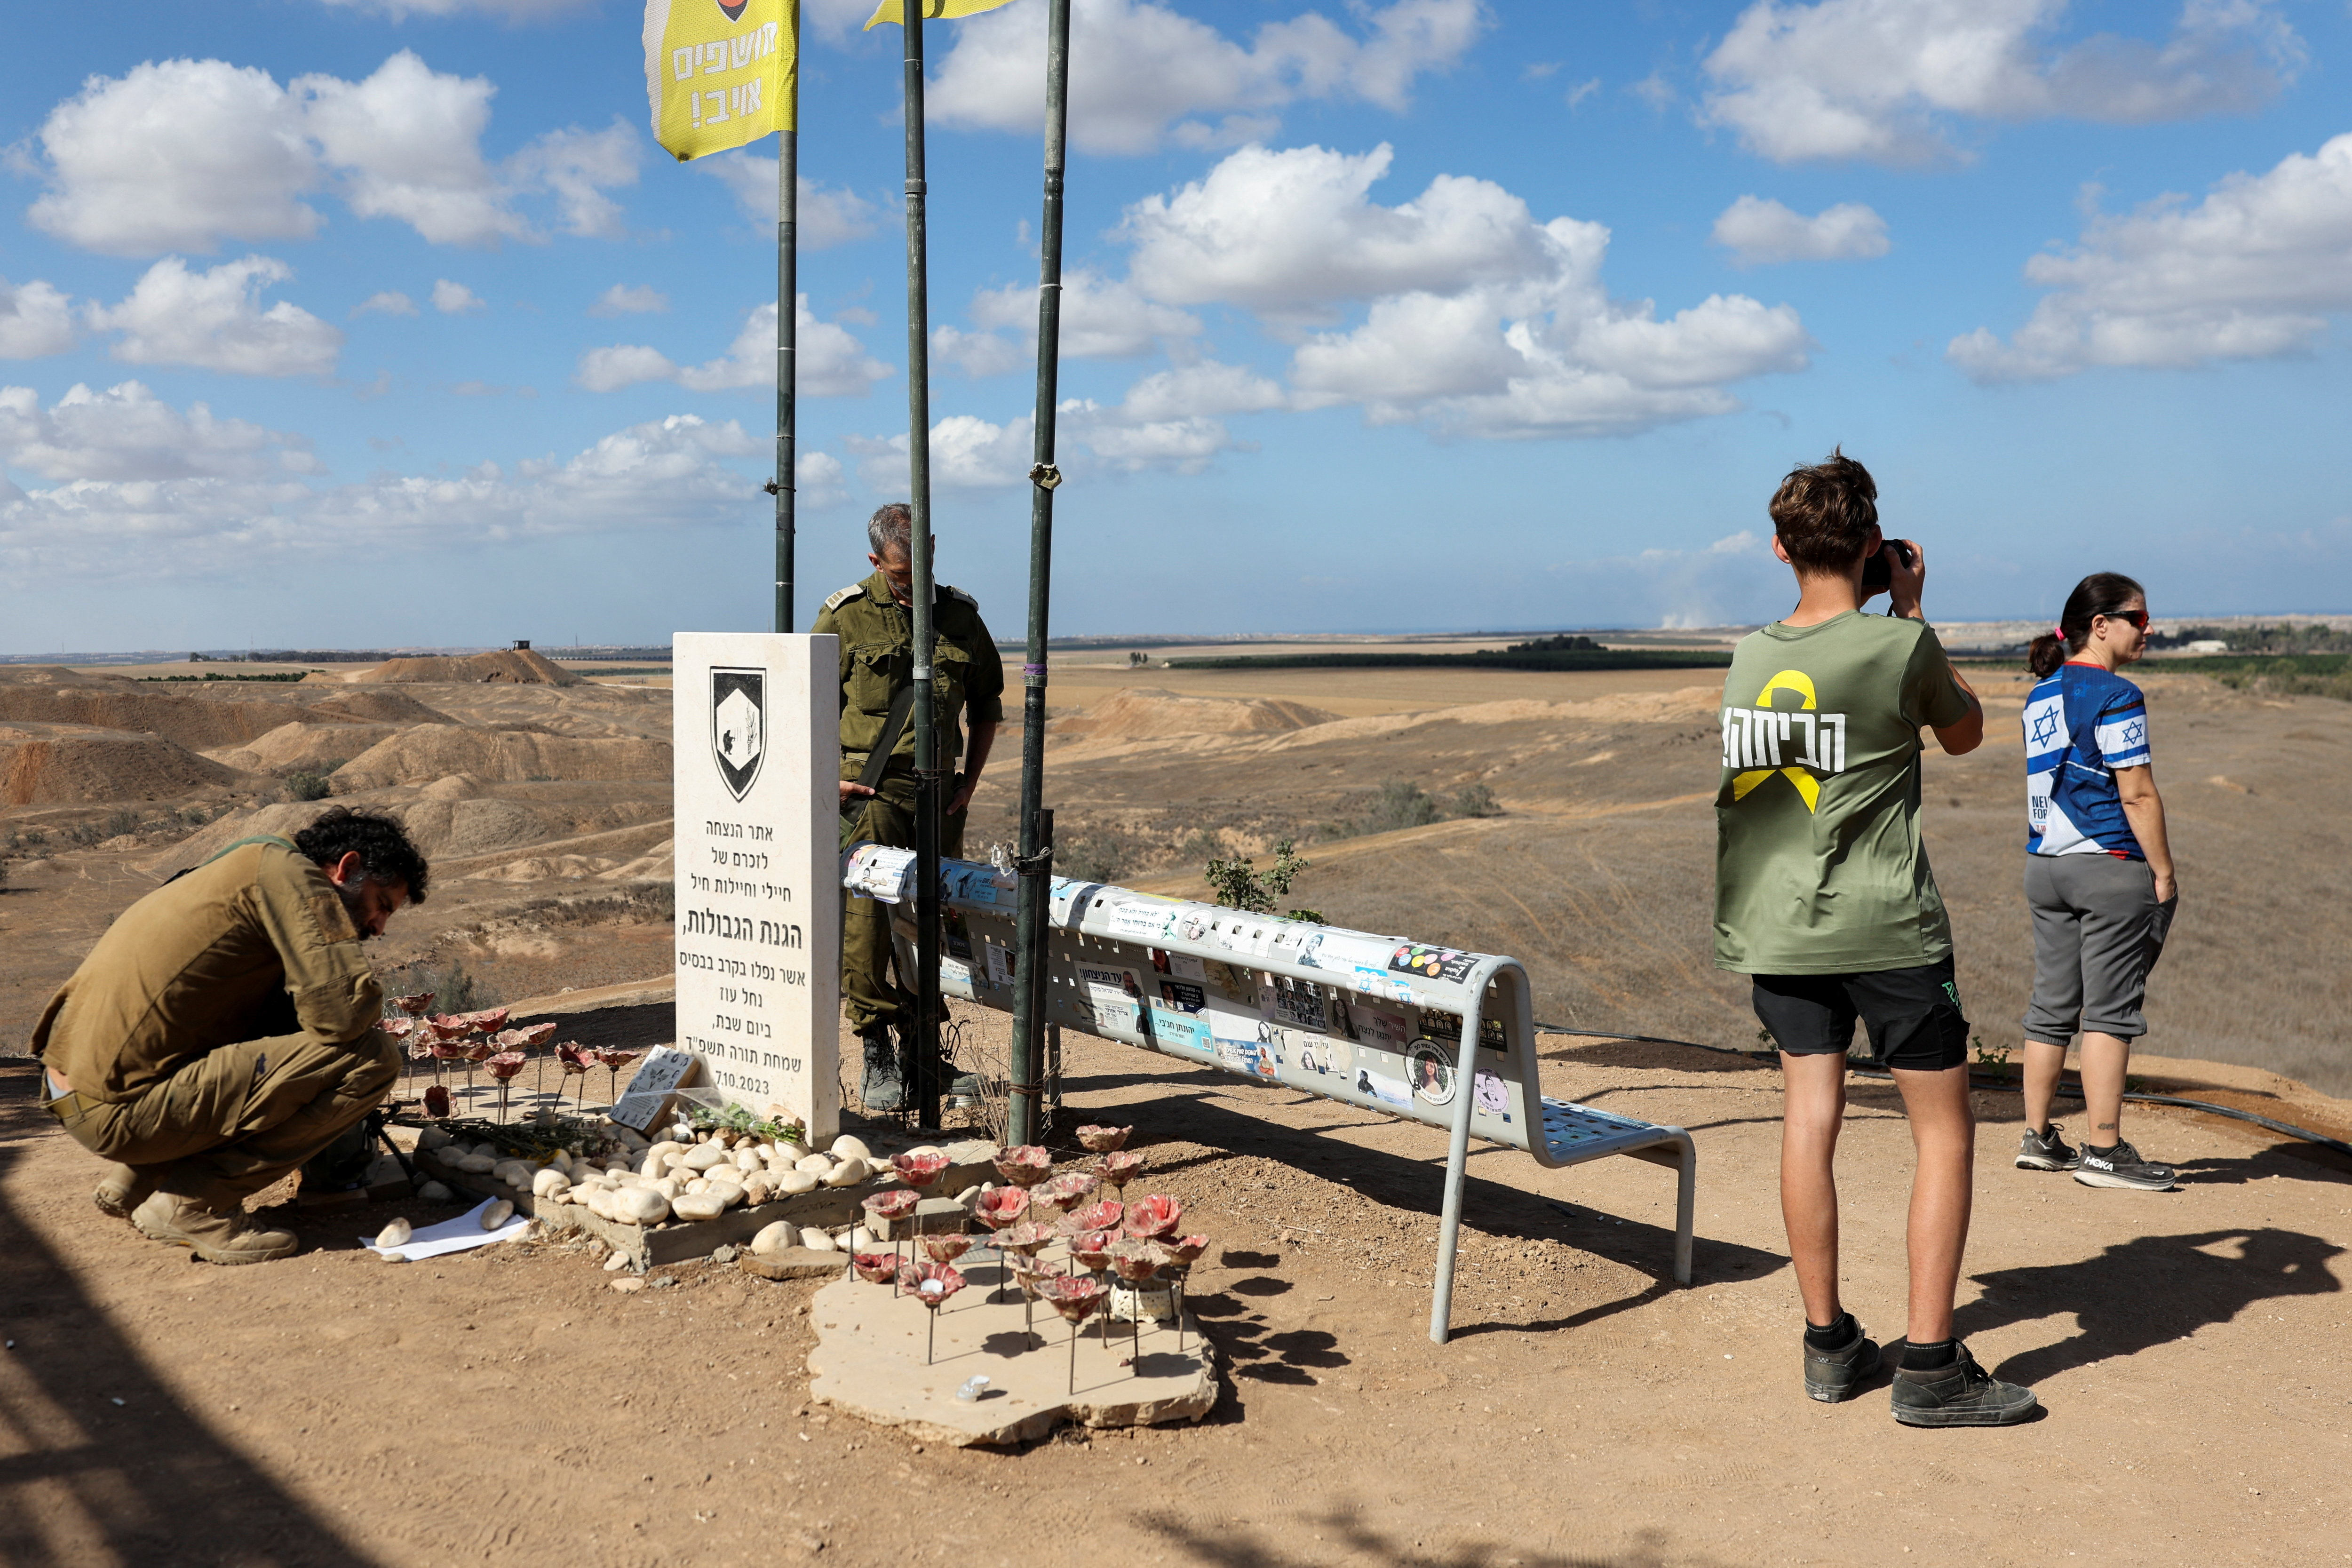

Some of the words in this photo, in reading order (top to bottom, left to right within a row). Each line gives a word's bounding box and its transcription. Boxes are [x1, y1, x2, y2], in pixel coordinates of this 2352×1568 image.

[691, 77, 762, 129] אויב!
[1722, 707, 1845, 772] הביתה!
[707, 821, 742, 838] הנצחה
[748, 825, 773, 841] אתר
[712, 847, 727, 865] של
[733, 852, 768, 869] לזכרם
[691, 873, 709, 891] חיל
[715, 878, 756, 898] וחיילות
[762, 883, 791, 902] חיילי
[683, 907, 753, 941] הגבולות,
[760, 920, 802, 949] הגנת
[680, 952, 713, 970] בבסיס
[718, 958, 747, 978] בקרב
[751, 962, 775, 981] נפלו
[779, 968, 806, 987] אשר
[1079, 968, 1111, 981] הניצחון!
[1111, 972, 1122, 983] עד
[720, 987, 736, 1003] עוז
[742, 988, 763, 1008] נחל
[712, 1015, 741, 1031] שבת,
[747, 1020, 771, 1038] ביום
[1176, 1023, 1194, 1034] יהונתן
[730, 1045, 758, 1064] תורה
[763, 1052, 801, 1073] שמחת
[715, 1070, 769, 1095] 7.10.2023
[2084, 1156, 2114, 1171] HOKA
